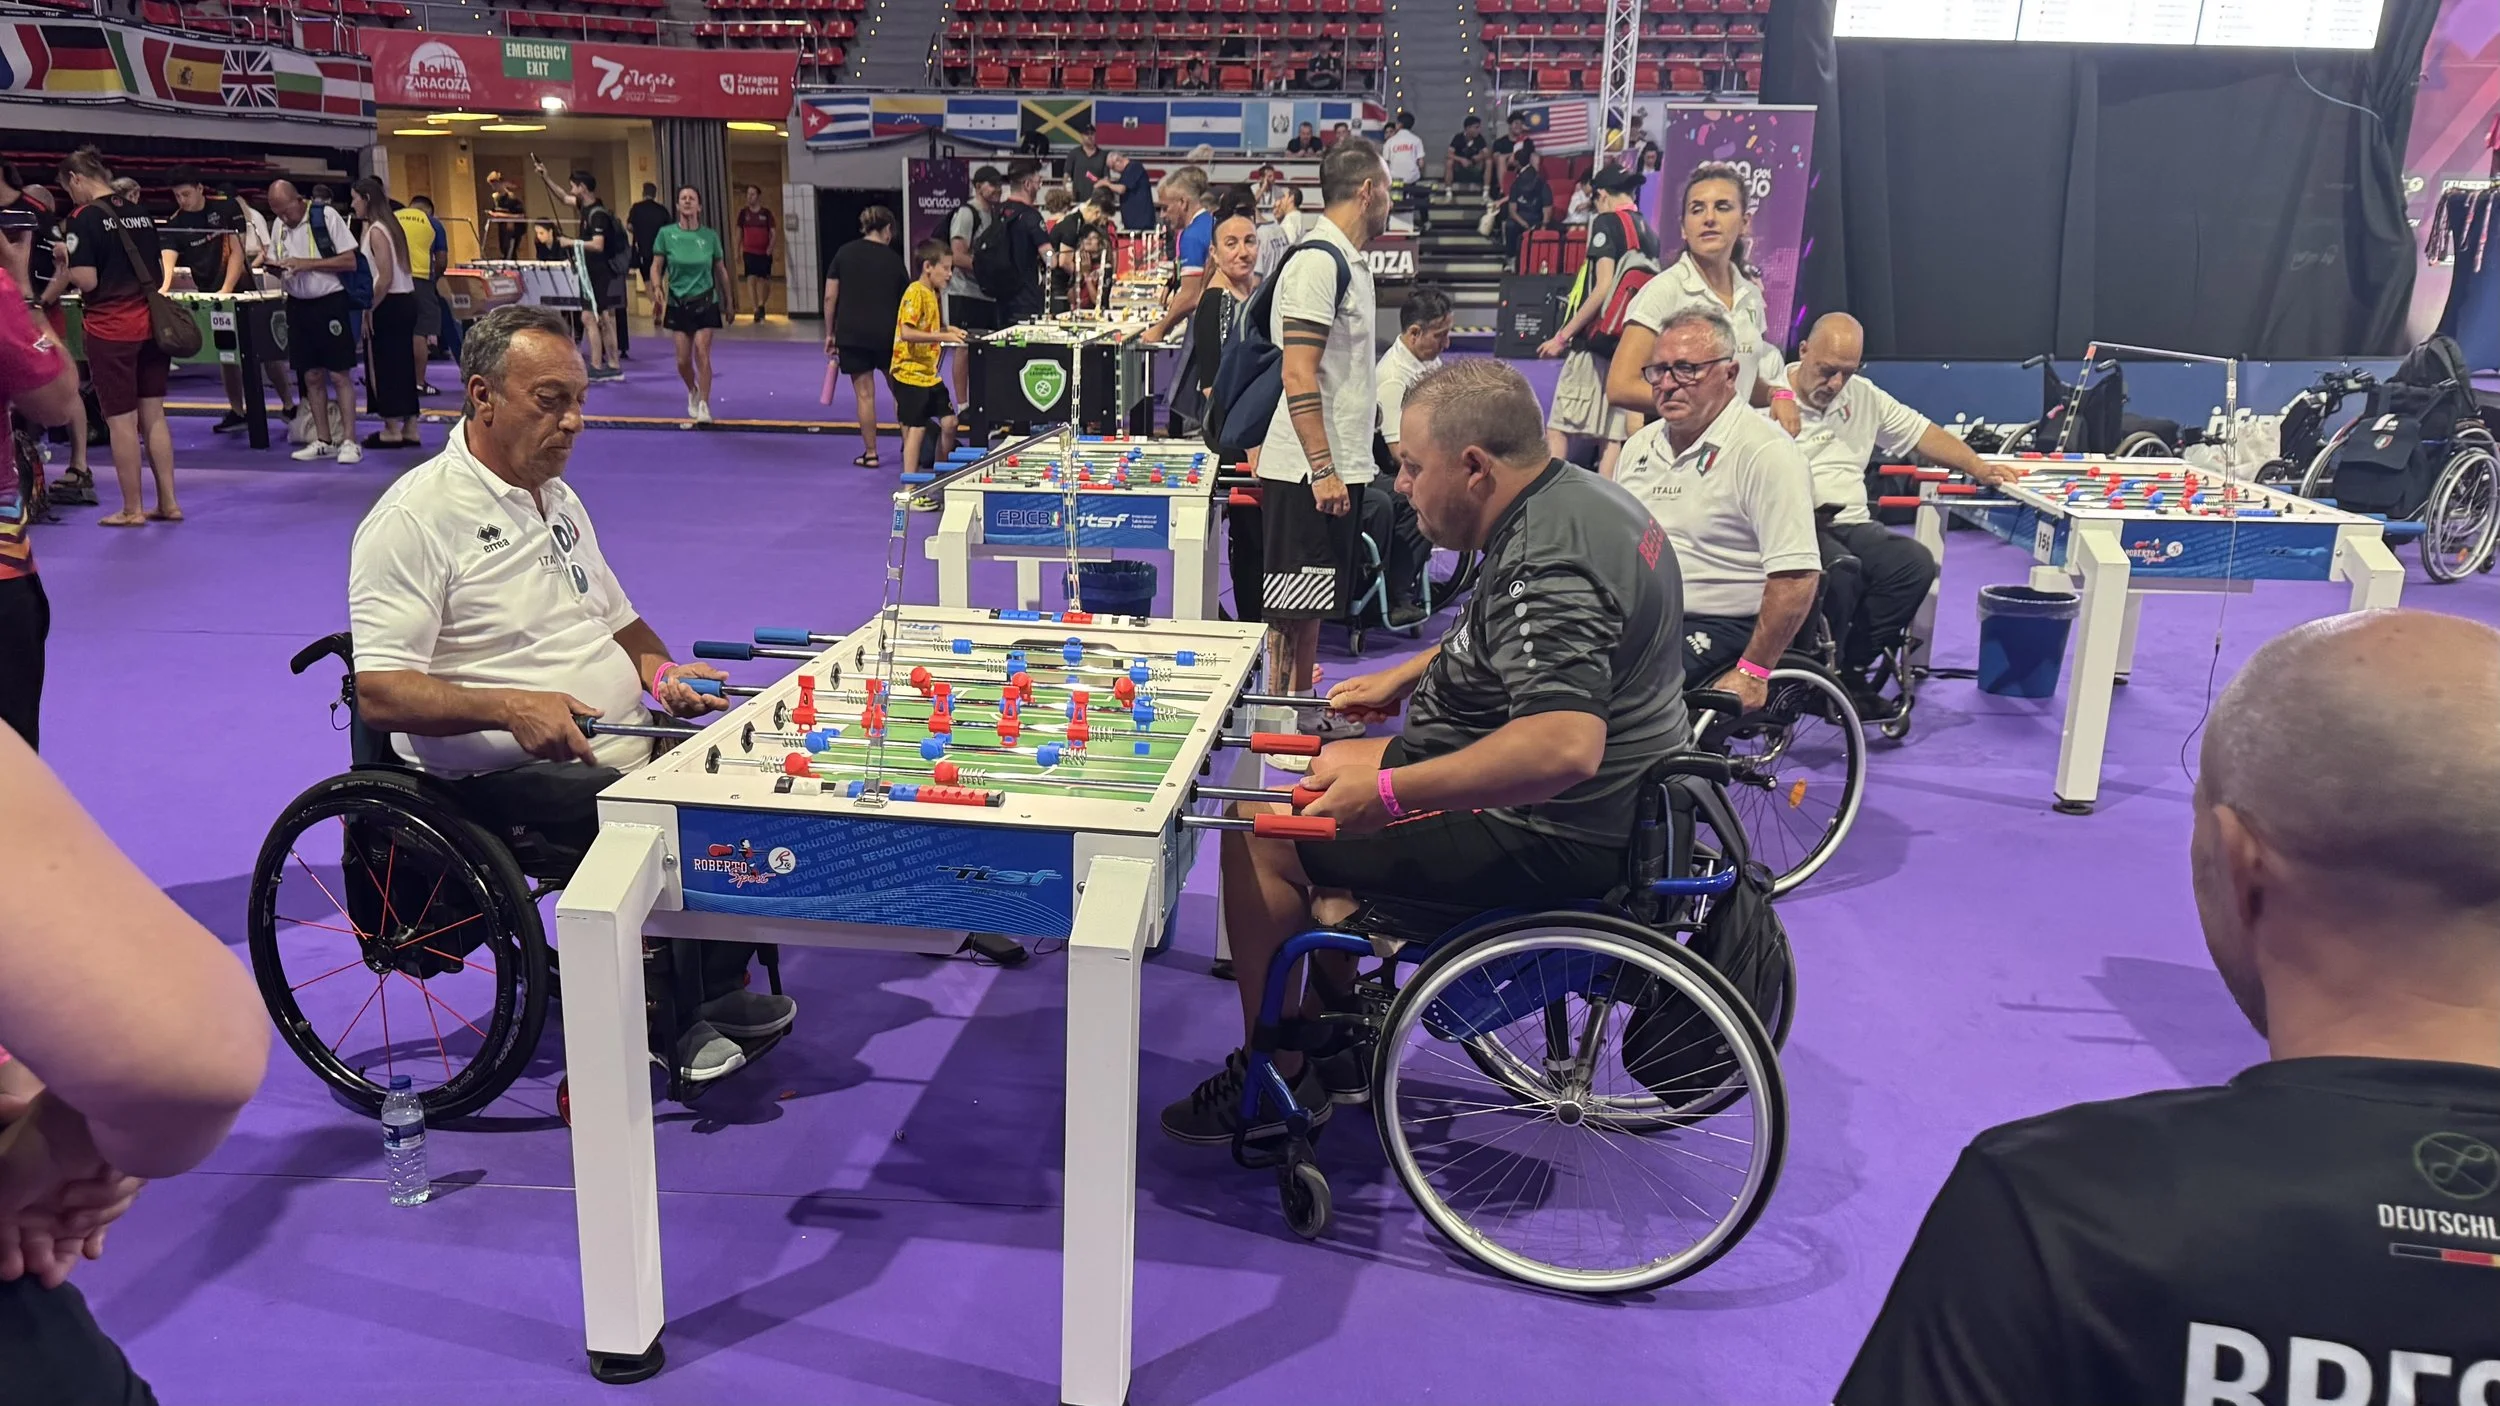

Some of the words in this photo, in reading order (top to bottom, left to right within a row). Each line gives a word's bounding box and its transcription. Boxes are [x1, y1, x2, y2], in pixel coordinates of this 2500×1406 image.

[506, 42, 567, 60] EMERGENCY
[526, 61, 550, 77] EXIT
[405, 75, 471, 93] ZARAGOZA
[737, 74, 779, 86] Zaragoza
[213, 317, 232, 327] 054
[1652, 486, 1682, 495] ITALIA
[1076, 513, 1130, 529] itsf
[862, 835, 933, 863] REVOLUTION
[694, 858, 748, 874] ROBERTO
